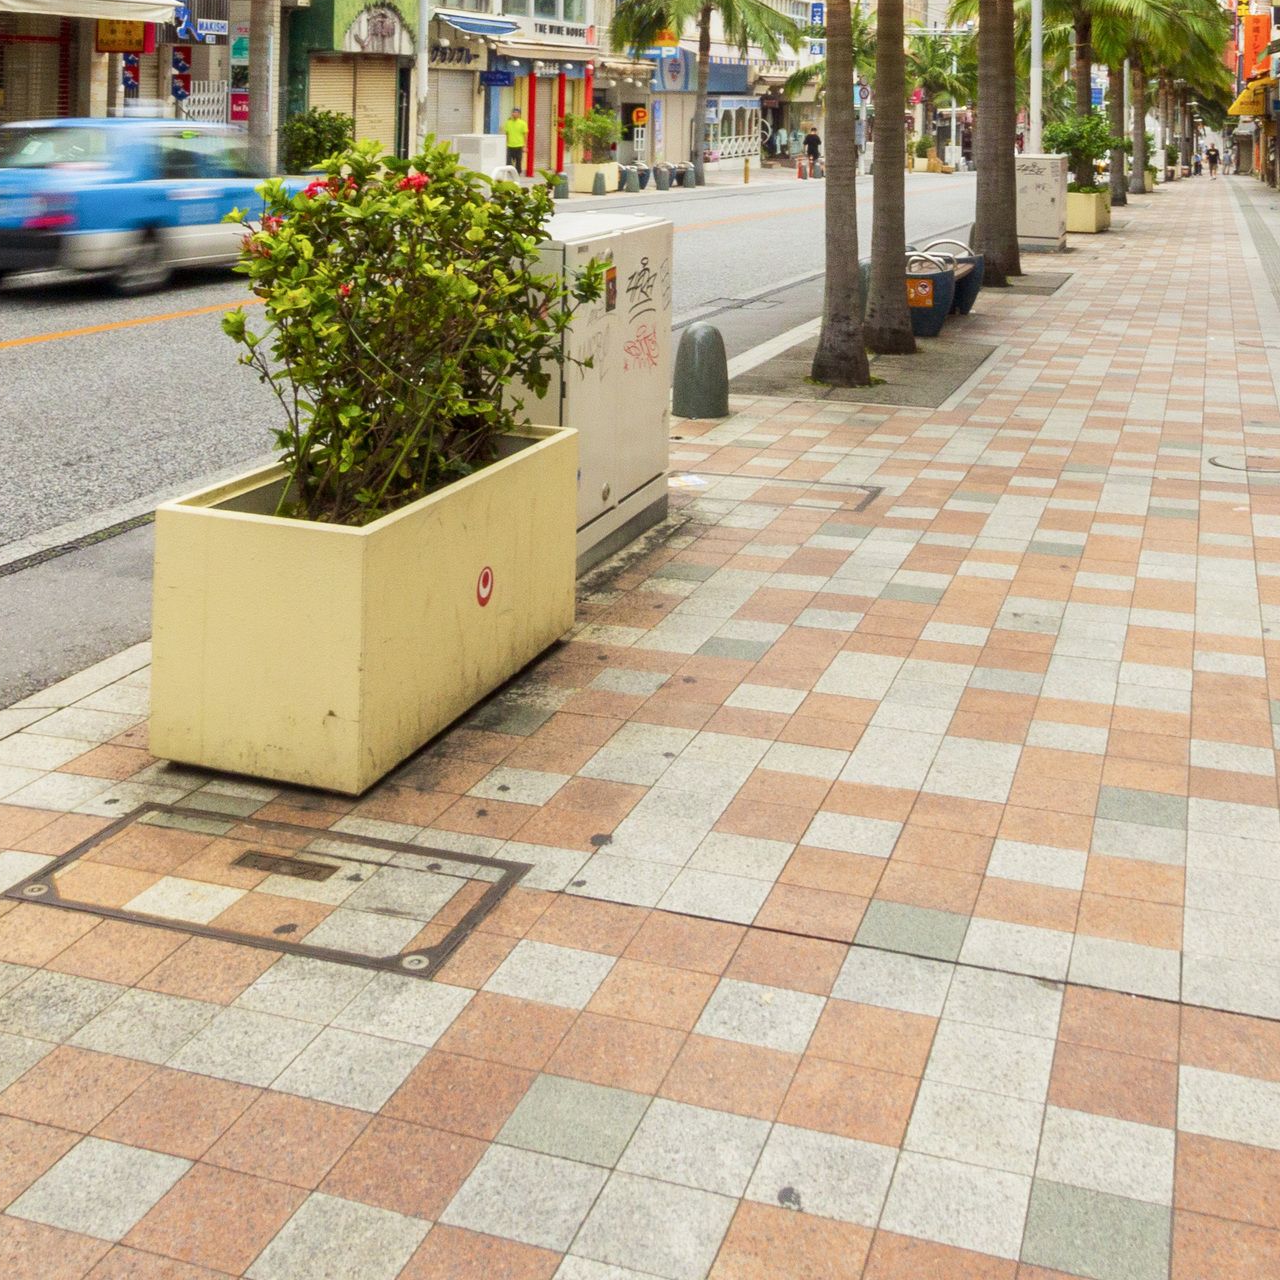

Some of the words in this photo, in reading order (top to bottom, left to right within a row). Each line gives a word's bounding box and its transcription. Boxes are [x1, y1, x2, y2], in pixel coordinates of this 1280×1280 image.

[198, 22, 228, 34] MAKISHI
[534, 22, 547, 34] THE
[549, 24, 565, 36] WINE
[566, 26, 586, 38] HOUSE
[635, 109, 647, 121] P
